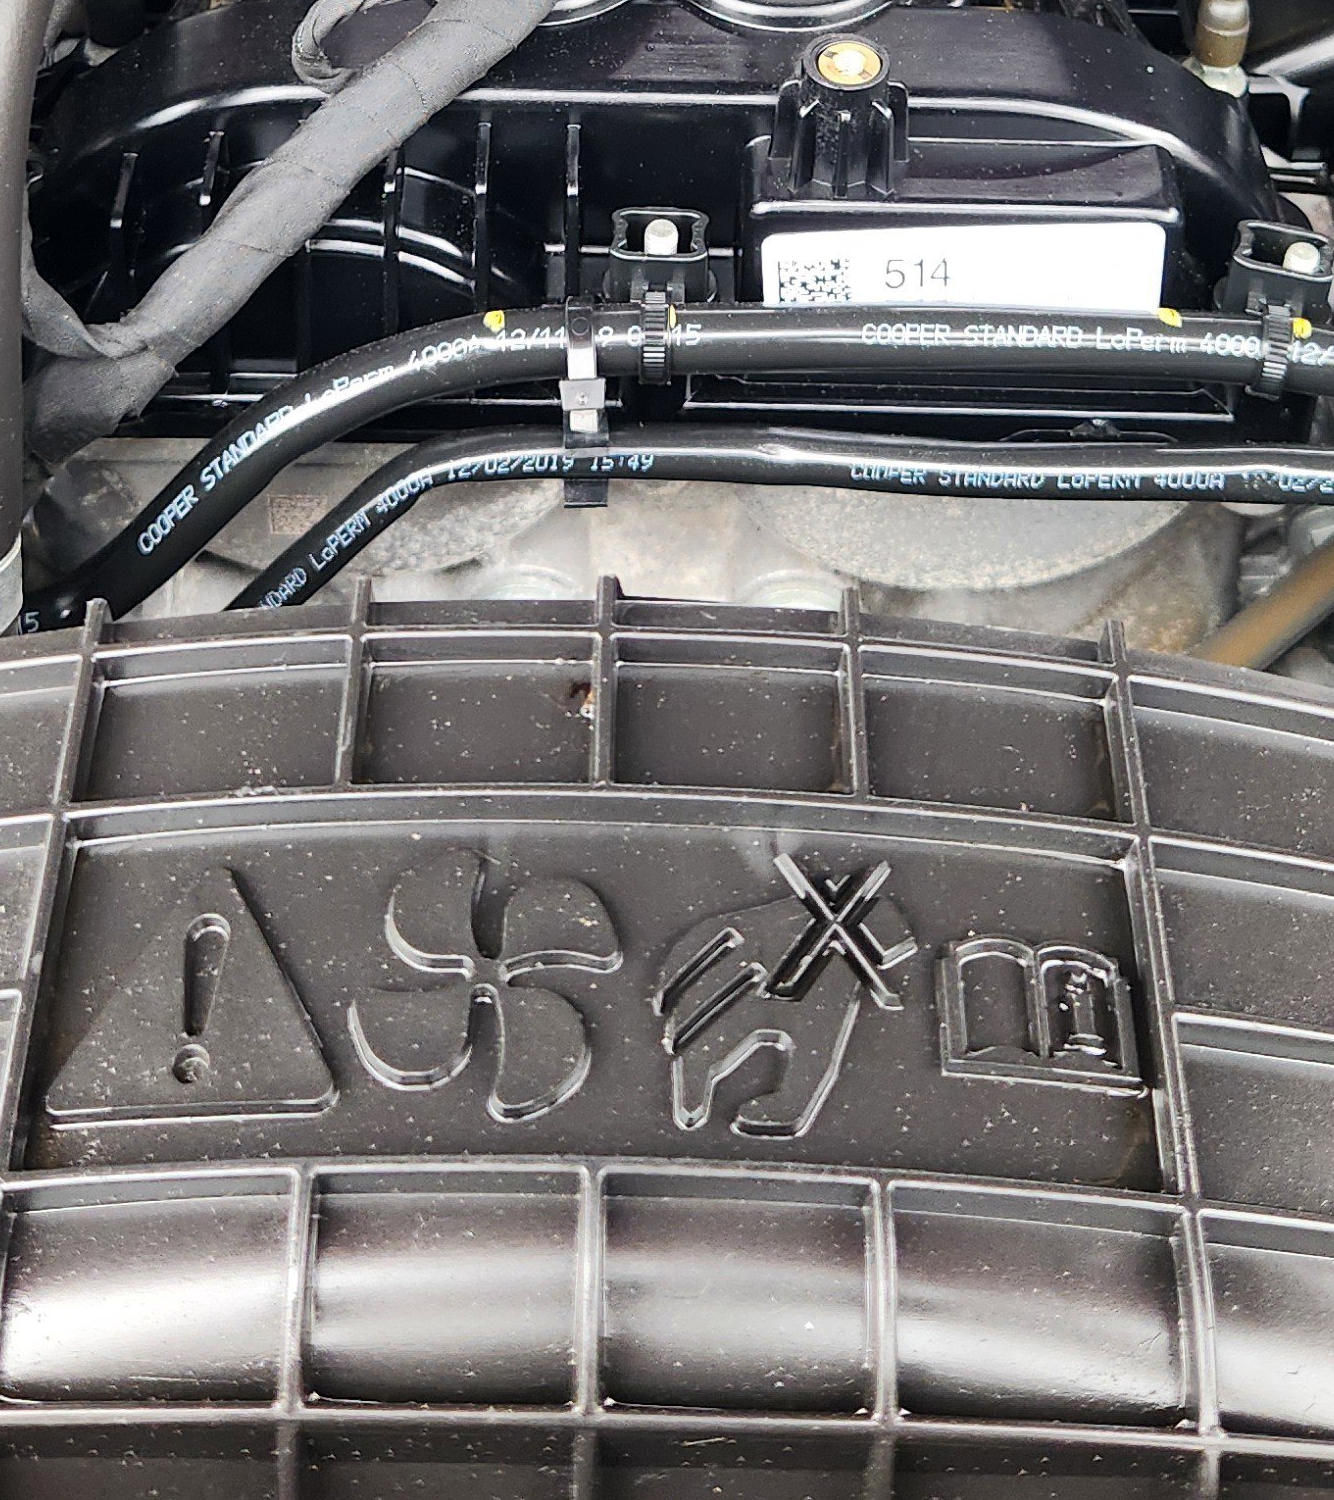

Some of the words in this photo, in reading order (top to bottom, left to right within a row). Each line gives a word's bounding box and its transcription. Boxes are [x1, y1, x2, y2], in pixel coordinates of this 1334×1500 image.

[884, 257, 951, 289] 514
[861, 323, 950, 346] COOPER
[963, 323, 1083, 348] STANDARD
[1096, 326, 1187, 354] LoPerm
[1199, 332, 1267, 360] 4000
[138, 486, 200, 557] COOPER
[200, 403, 296, 492] STANDARD
[850, 462, 927, 486] COOPER
[938, 469, 1045, 490] STANDARD
[1153, 471, 1226, 490] 4000A
[259, 566, 309, 612] NDARD
[447, 454, 575, 481] 12/02/2019
[589, 452, 655, 473] 15:49
